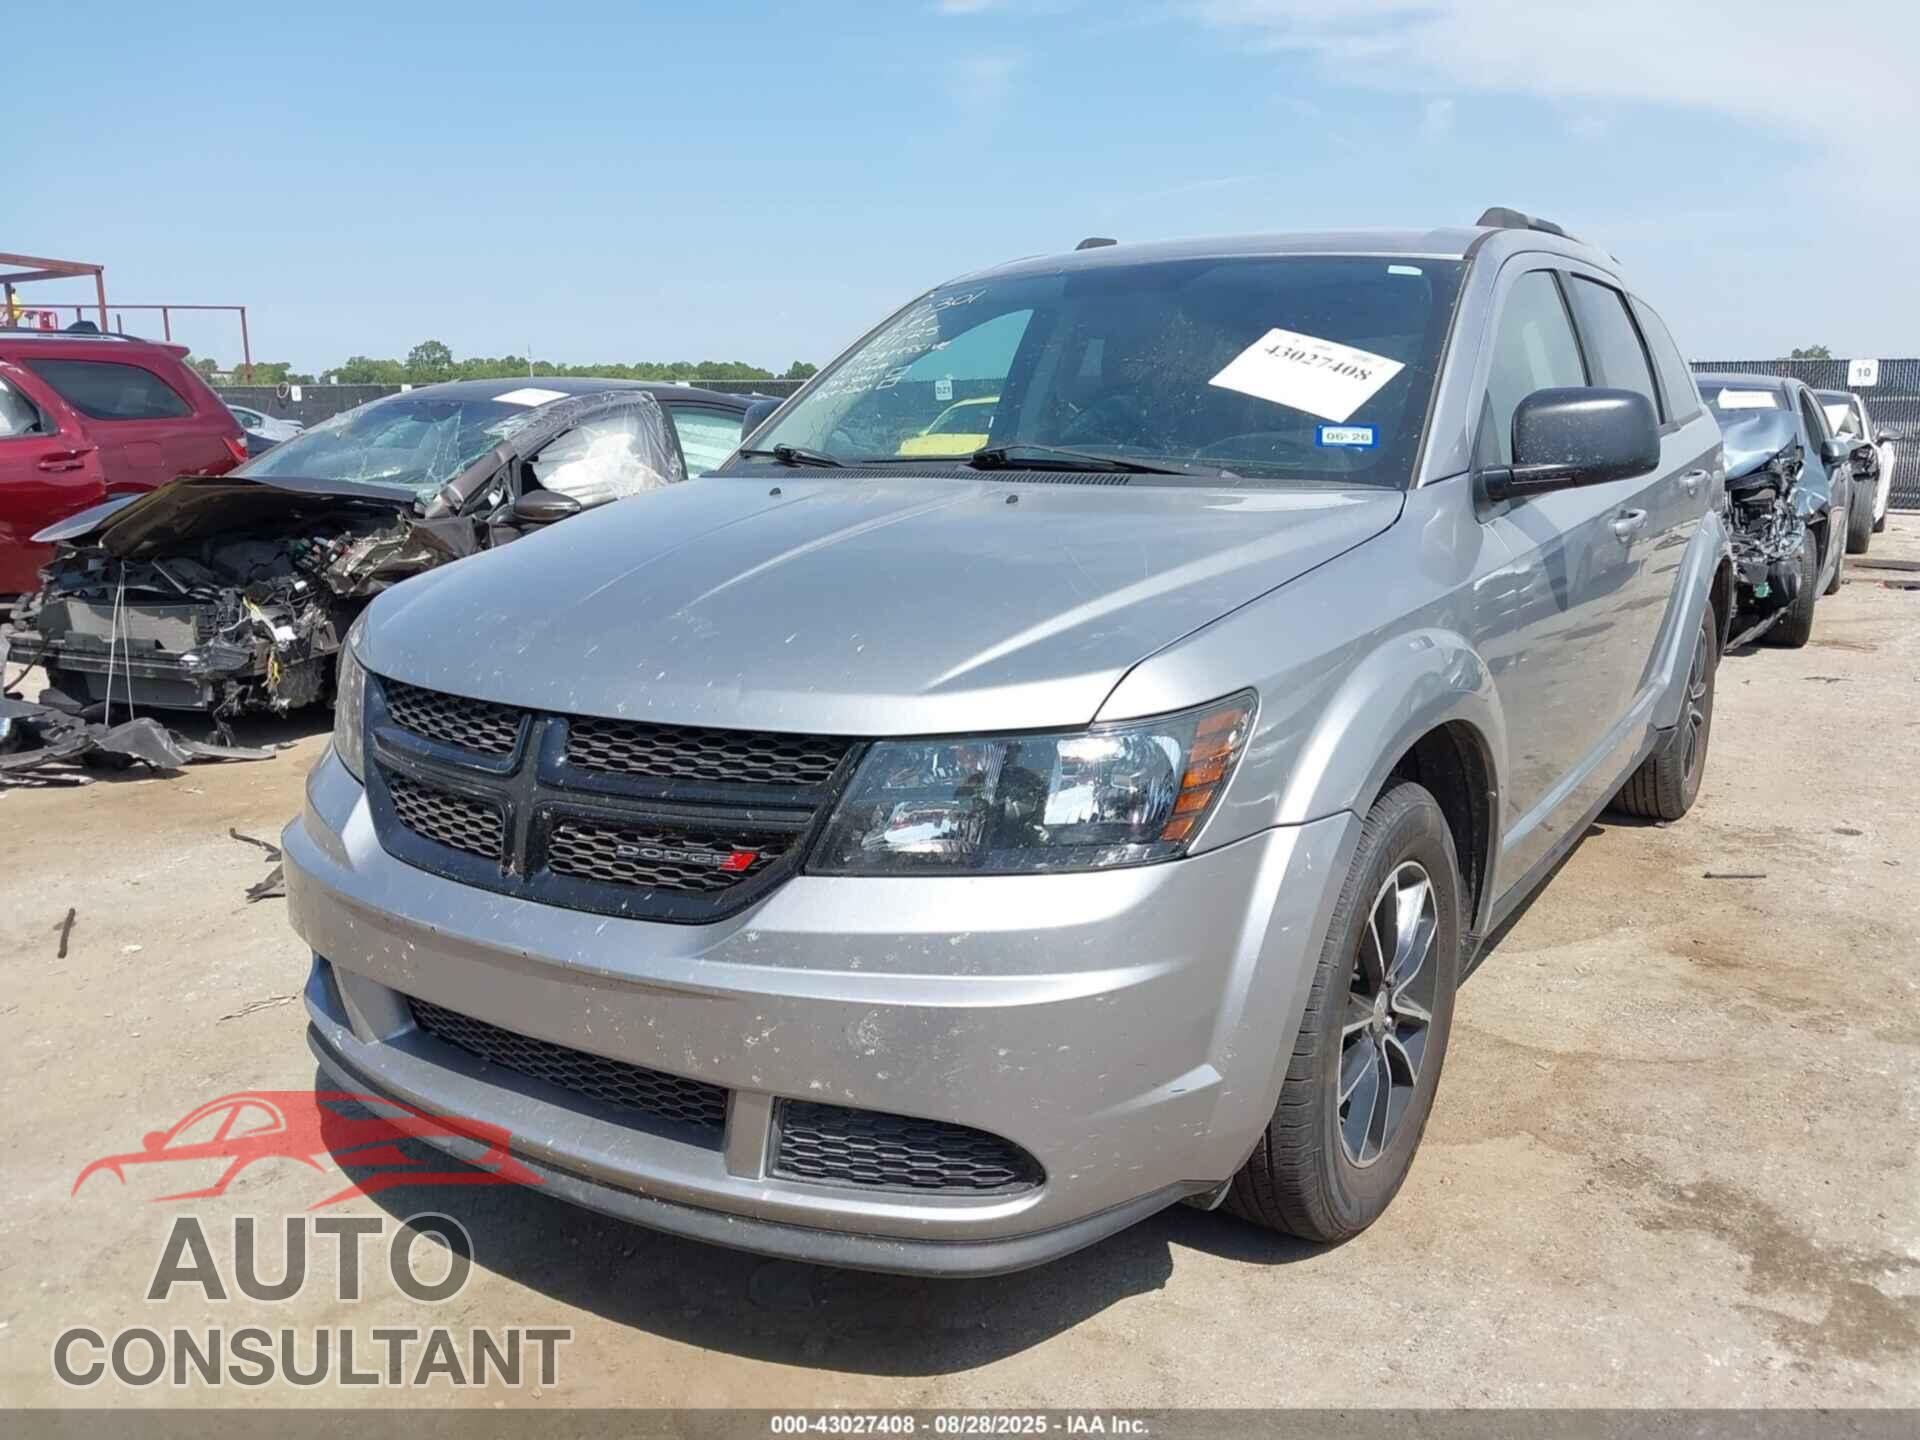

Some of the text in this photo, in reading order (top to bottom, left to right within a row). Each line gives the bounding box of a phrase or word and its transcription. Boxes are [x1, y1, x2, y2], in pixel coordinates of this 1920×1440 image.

[1264, 344, 1373, 381] 43027408
[1856, 367, 1871, 377] 10
[616, 844, 735, 867] DODGE
